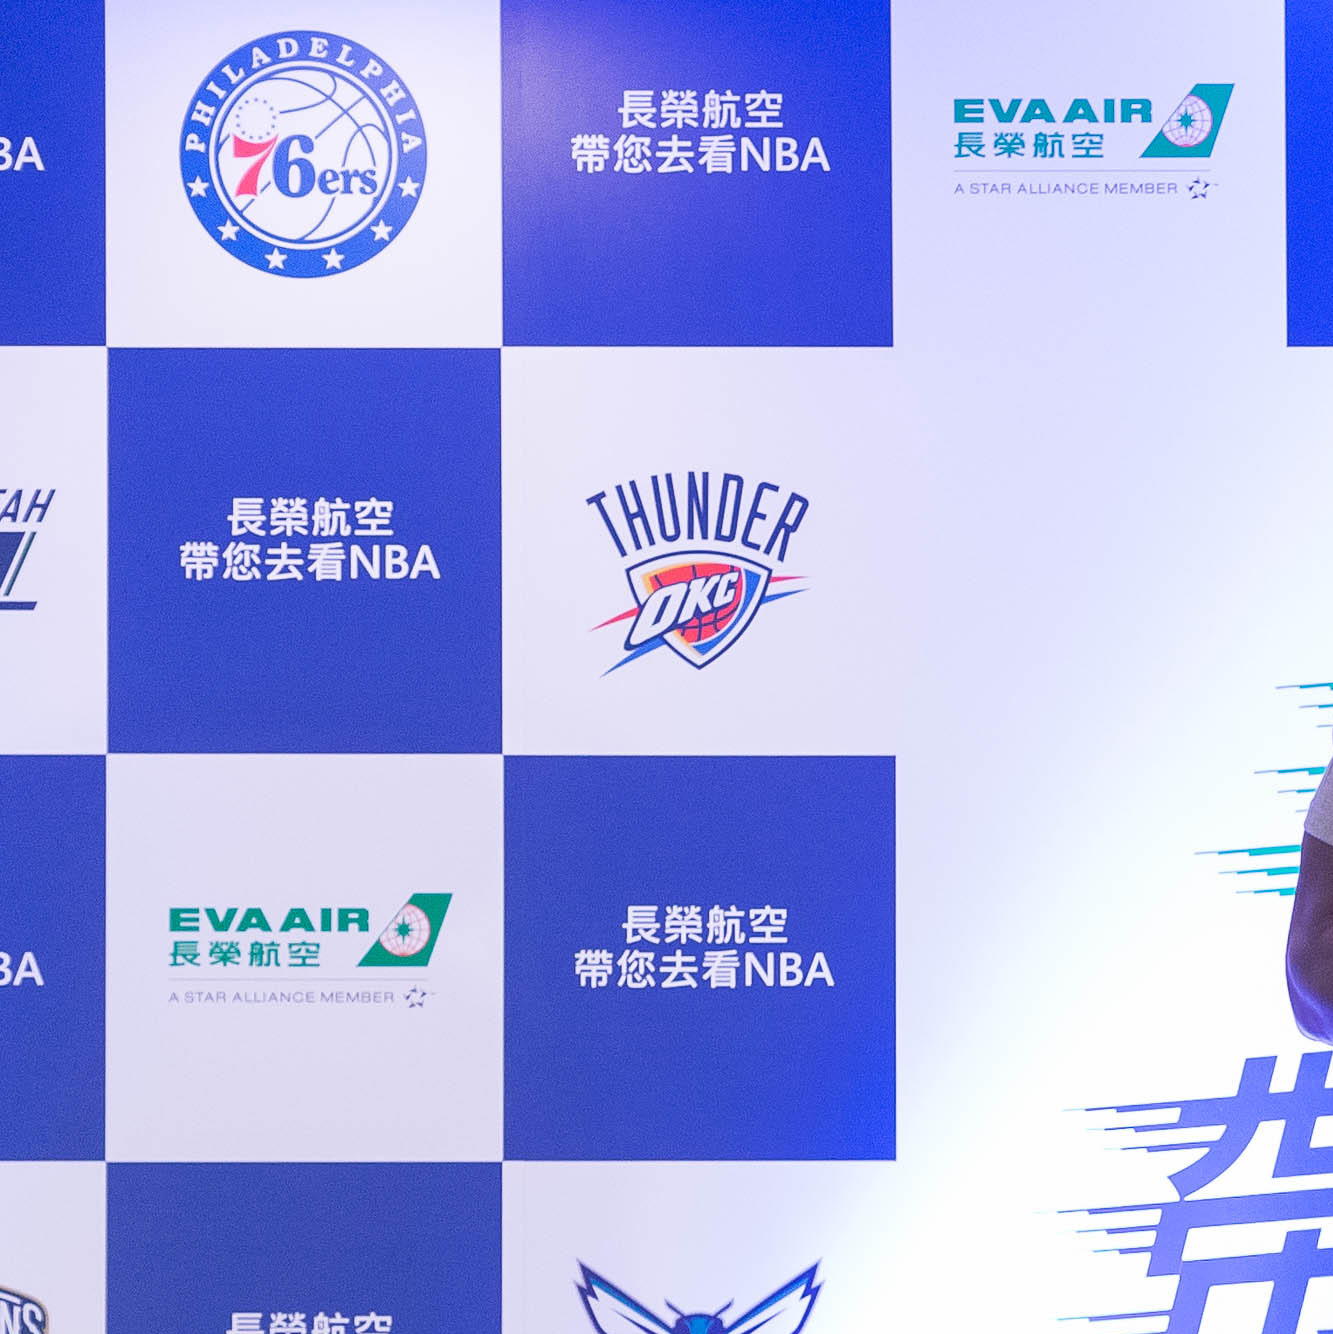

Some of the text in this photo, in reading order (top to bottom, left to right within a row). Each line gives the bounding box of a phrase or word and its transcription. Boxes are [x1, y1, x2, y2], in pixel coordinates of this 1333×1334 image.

[185, 37, 423, 154] PHILADELPHIA
[617, 89, 783, 129] 長榮航空
[953, 98, 1153, 123] EVA AIR
[570, 133, 831, 174] 帶您去看NBA
[953, 132, 1104, 158] 長榮航空
[232, 133, 378, 198] 76ers
[953, 182, 1178, 195] A STAR ALLIANCE MEMBER
[226, 496, 394, 537] 長榮航空
[586, 471, 809, 562] THUNDER
[179, 541, 441, 581] 帶您去看NBA
[627, 570, 742, 647] OKC
[169, 908, 370, 933] EVA AIR
[621, 904, 788, 945] 長榮航空
[169, 941, 320, 968] 長榮航空
[574, 949, 835, 989] 帶您去看NBA
[168, 991, 394, 1003] A STAR ALLIANCE MEMBER
